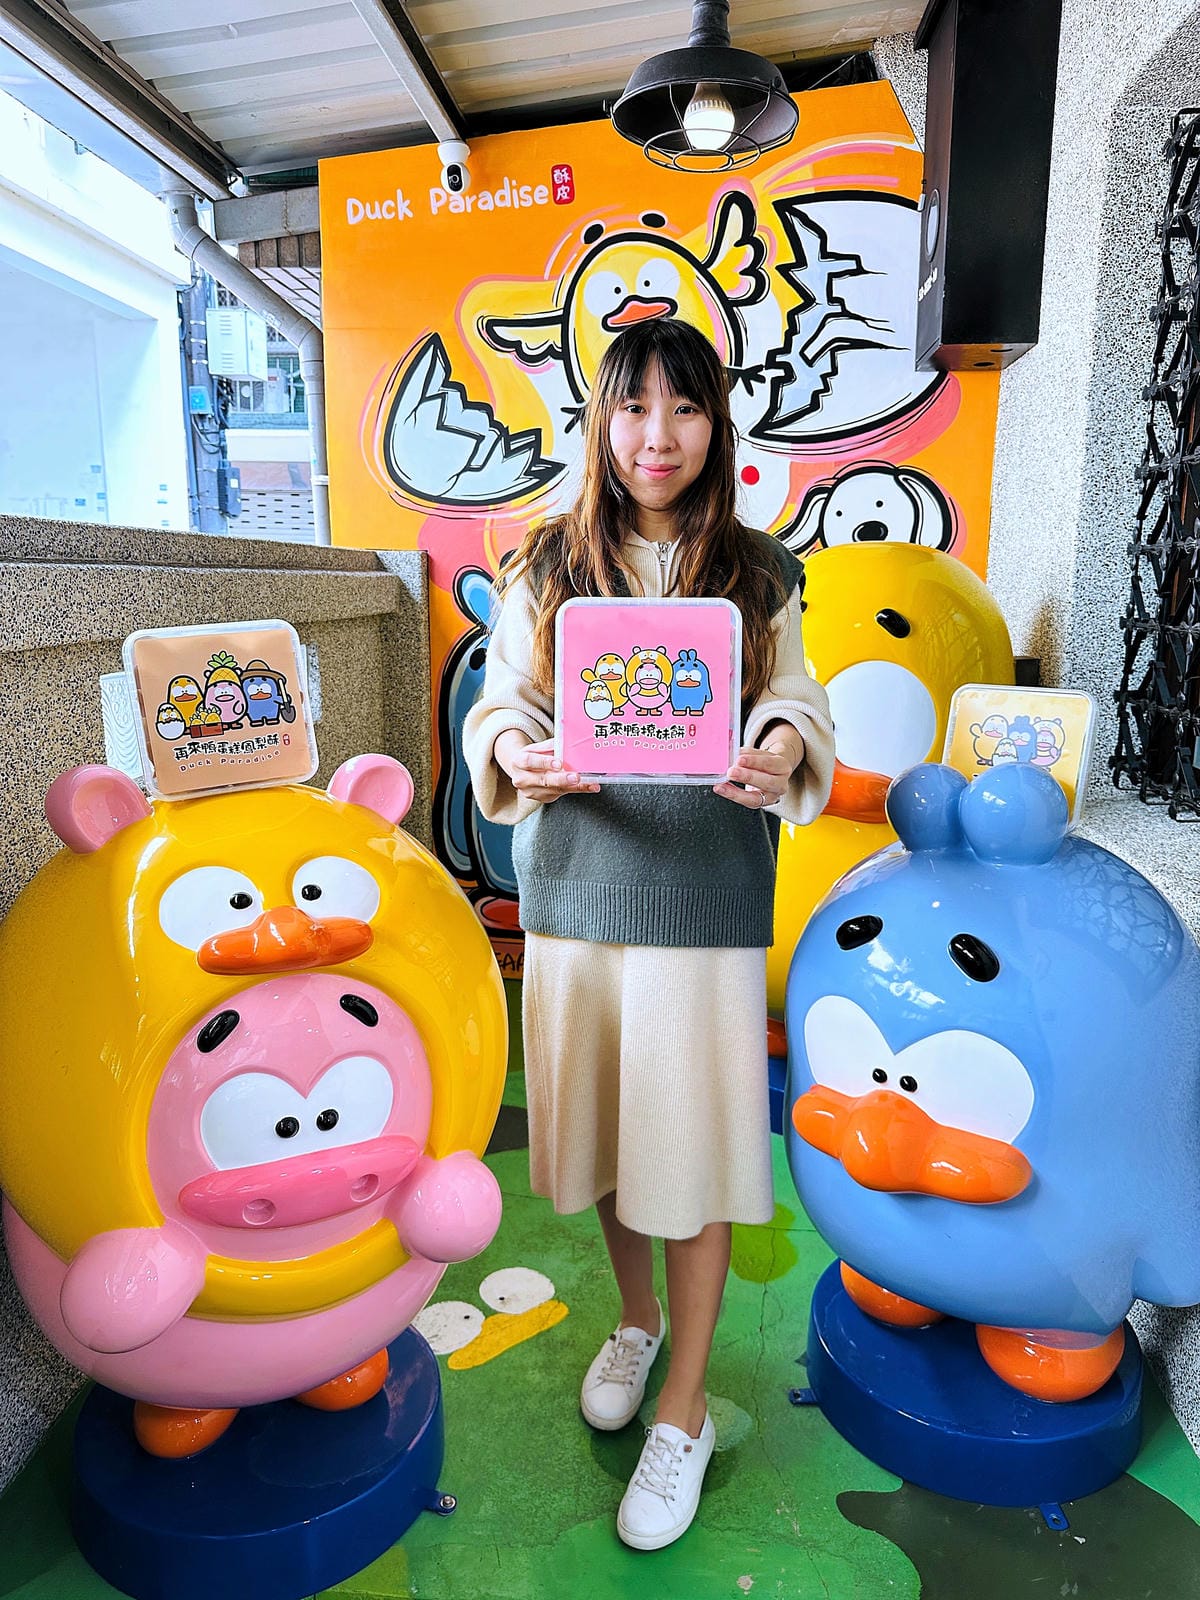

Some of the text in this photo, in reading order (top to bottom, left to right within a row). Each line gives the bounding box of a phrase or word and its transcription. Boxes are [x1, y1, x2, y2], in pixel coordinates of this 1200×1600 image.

[553, 167, 571, 201] 酥皮
[346, 176, 549, 225] Duck Paradise
[173, 733, 280, 761] 再來鴨蛋糕鳳梨酥
[594, 739, 696, 750] Duck Paradise
[180, 750, 280, 772] Duck Paradise
